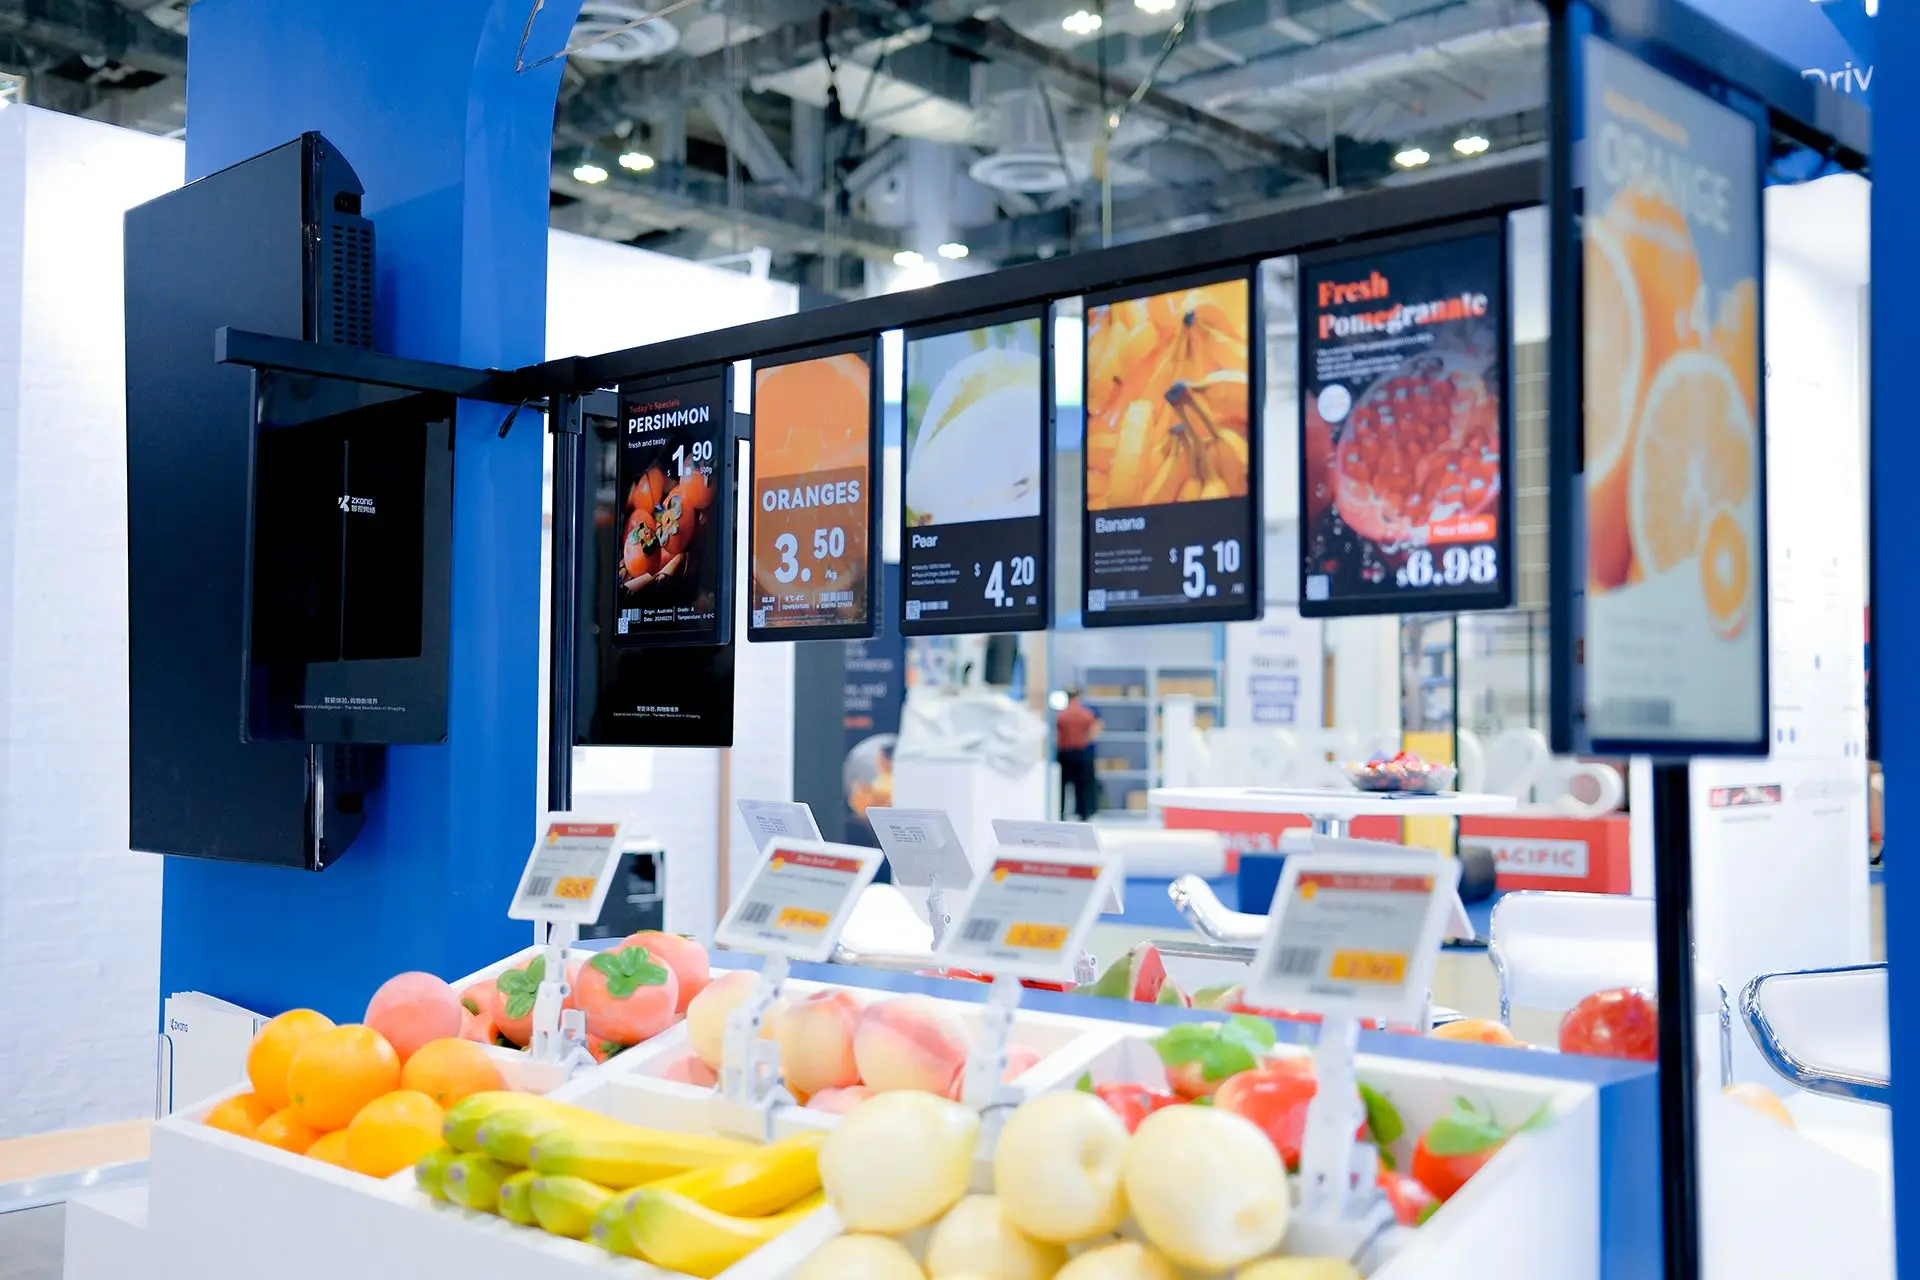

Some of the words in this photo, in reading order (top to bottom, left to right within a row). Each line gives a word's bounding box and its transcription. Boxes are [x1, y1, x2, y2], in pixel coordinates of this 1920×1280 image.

[1317, 270, 1389, 307] Fresh
[1317, 292, 1488, 340] Pomegranate
[628, 406, 709, 434] PERSIMMON
[628, 441, 641, 449] fresh
[642, 439, 652, 448] and
[652, 437, 666, 446] tasty
[762, 480, 861, 512] ORANGES
[1095, 516, 1146, 534] Banana
[912, 534, 938, 549] Pear
[1169, 547, 1178, 564] $
[974, 562, 981, 577] $
